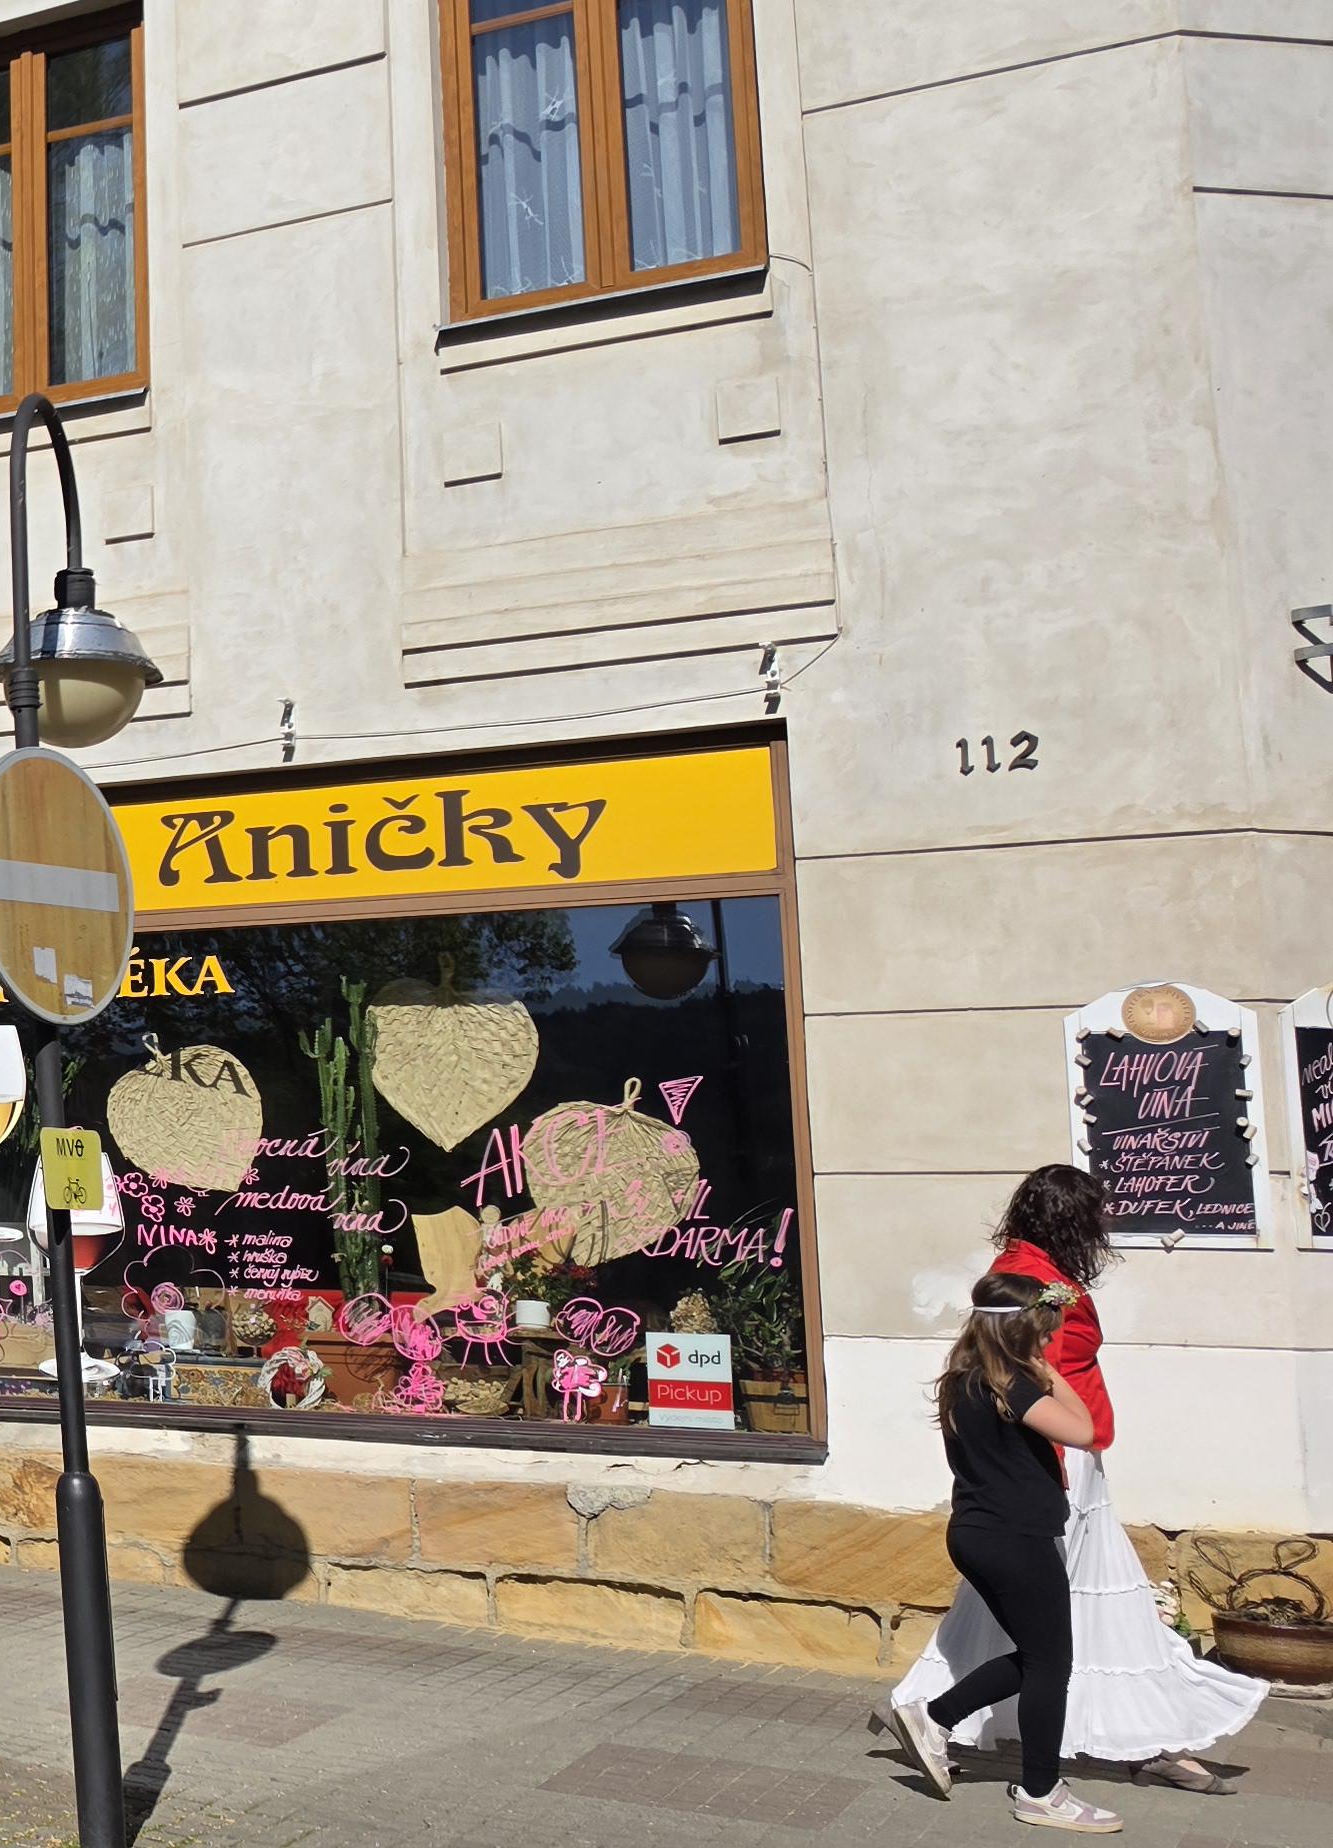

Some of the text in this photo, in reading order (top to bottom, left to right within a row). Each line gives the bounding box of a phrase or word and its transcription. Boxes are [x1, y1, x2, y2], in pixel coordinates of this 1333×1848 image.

[956, 730, 1039, 776] 112
[158, 788, 608, 887] Aničky
[1138, 1086, 1209, 1119] VÍNA
[1113, 1127, 1220, 1153] VINAŘSTVÍ
[1110, 1151, 1226, 1174] ŠTĚPÁNEK
[1115, 1174, 1215, 1197] LAHOFER
[215, 1182, 343, 1215] medová
[1196, 1201, 1255, 1216] LEDNICE
[242, 1230, 293, 1248] malina
[243, 1247, 288, 1264] hruška
[688, 1349, 721, 1368] dpd
[657, 1384, 723, 1405] Pickup
